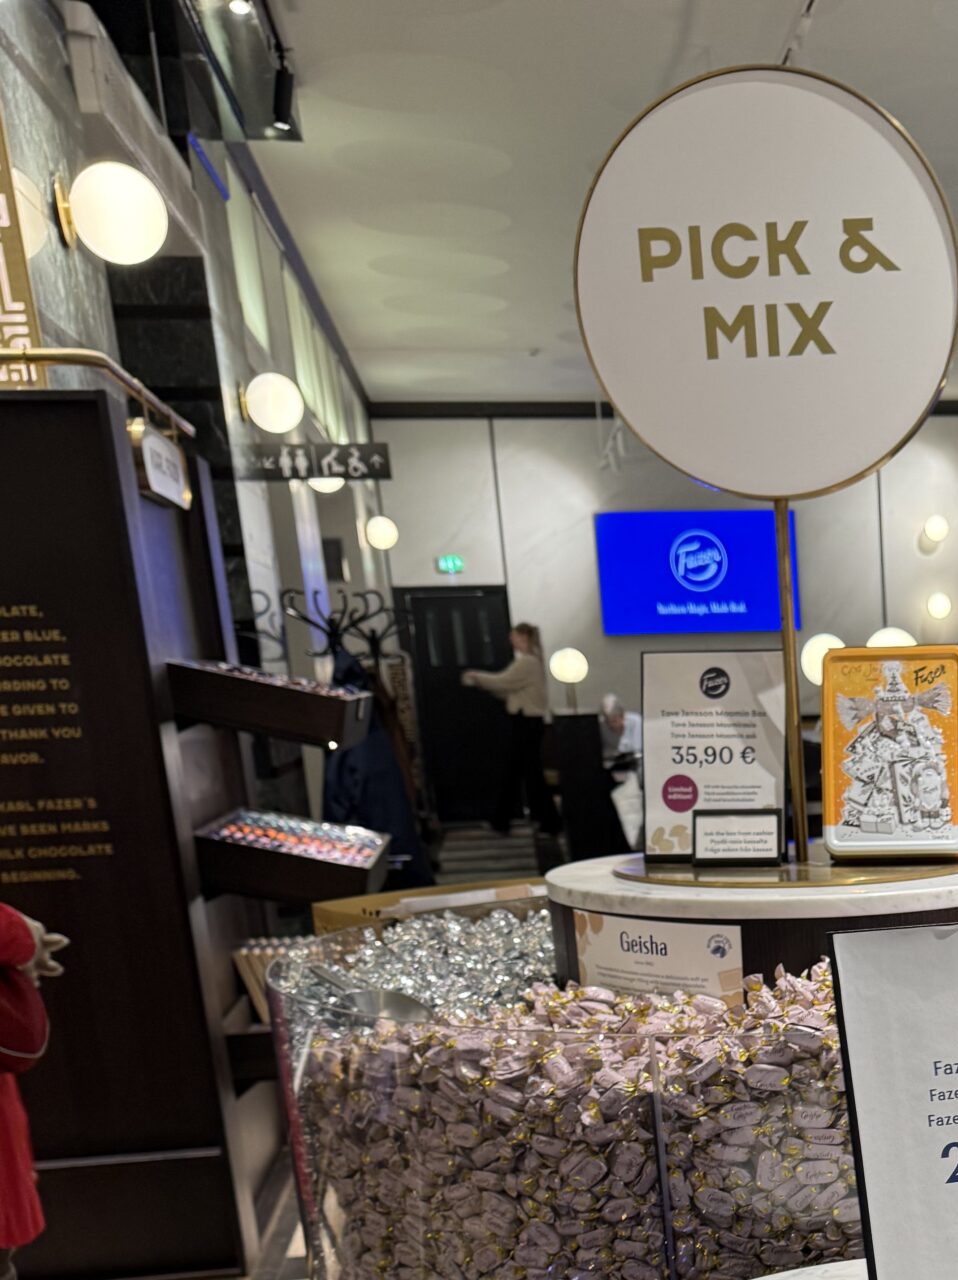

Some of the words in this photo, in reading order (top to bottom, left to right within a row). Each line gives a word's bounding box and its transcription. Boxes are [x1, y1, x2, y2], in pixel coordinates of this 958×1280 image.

[637, 220, 811, 282] PICK
[839, 217, 902, 274] &
[703, 301, 837, 360] MIX
[0, 605, 44, 618] LATE,
[23, 628, 67, 642] BLUE,
[49, 678, 70, 690] TO
[11, 703, 56, 716] GIVEN
[58, 702, 79, 714] TO
[51, 726, 82, 738] YOU
[671, 746, 733, 768] 35,90
[740, 746, 756, 765] €
[27, 843, 114, 859] CHOCOLATE
[620, 931, 668, 957] Geisha
